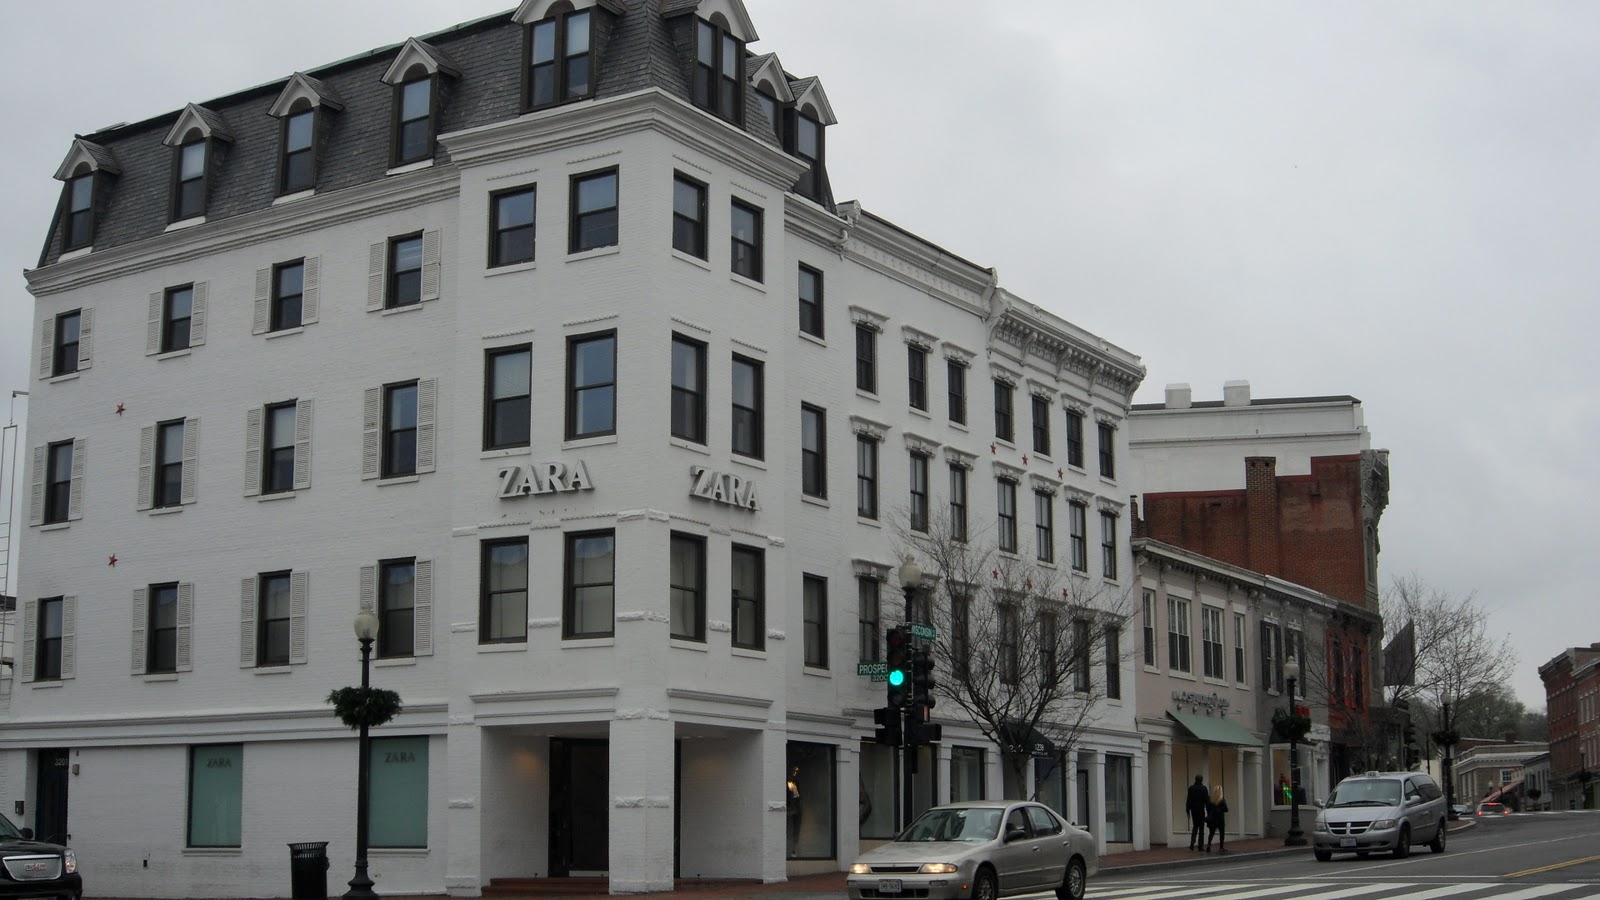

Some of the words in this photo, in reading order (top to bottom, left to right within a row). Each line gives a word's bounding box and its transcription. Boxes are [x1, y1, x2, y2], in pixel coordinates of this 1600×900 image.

[498, 459, 595, 499] ZARA
[690, 465, 760, 511] ZARA
[206, 757, 232, 768] ZARA
[383, 751, 416, 764] ZARA
